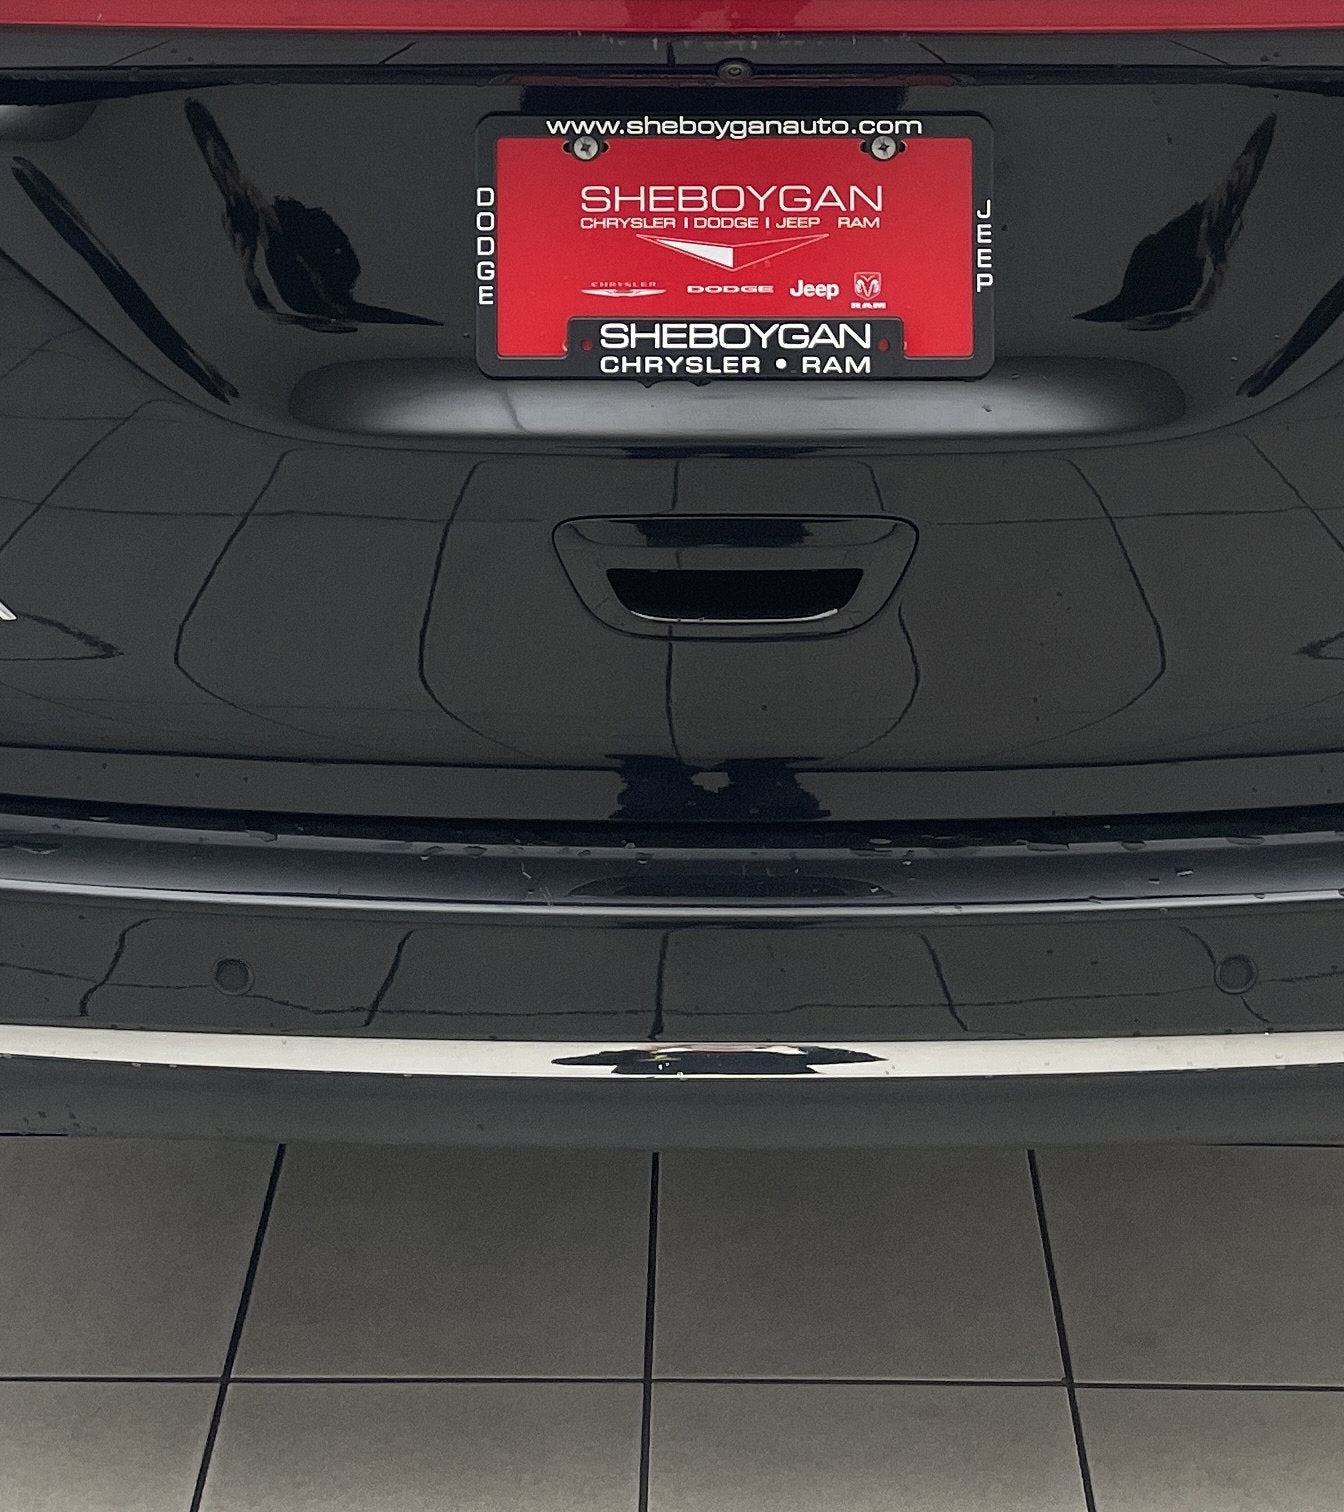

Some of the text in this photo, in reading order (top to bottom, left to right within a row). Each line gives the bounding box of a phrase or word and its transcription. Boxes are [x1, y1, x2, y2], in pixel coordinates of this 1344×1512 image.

[545, 116, 923, 140] www.sheboyganauto.com
[580, 185, 883, 213] SHEBOYGAN
[580, 217, 881, 229] CHRYSLER DODGE JEEP RAM
[475, 187, 495, 306] DODGE
[976, 199, 994, 293] JEEP
[686, 285, 774, 294] DODGE
[789, 279, 840, 301] Jeep
[850, 301, 887, 309] RAM
[600, 322, 871, 349] SHEBOYGAN
[600, 356, 871, 374] CHRYSLER RAM
